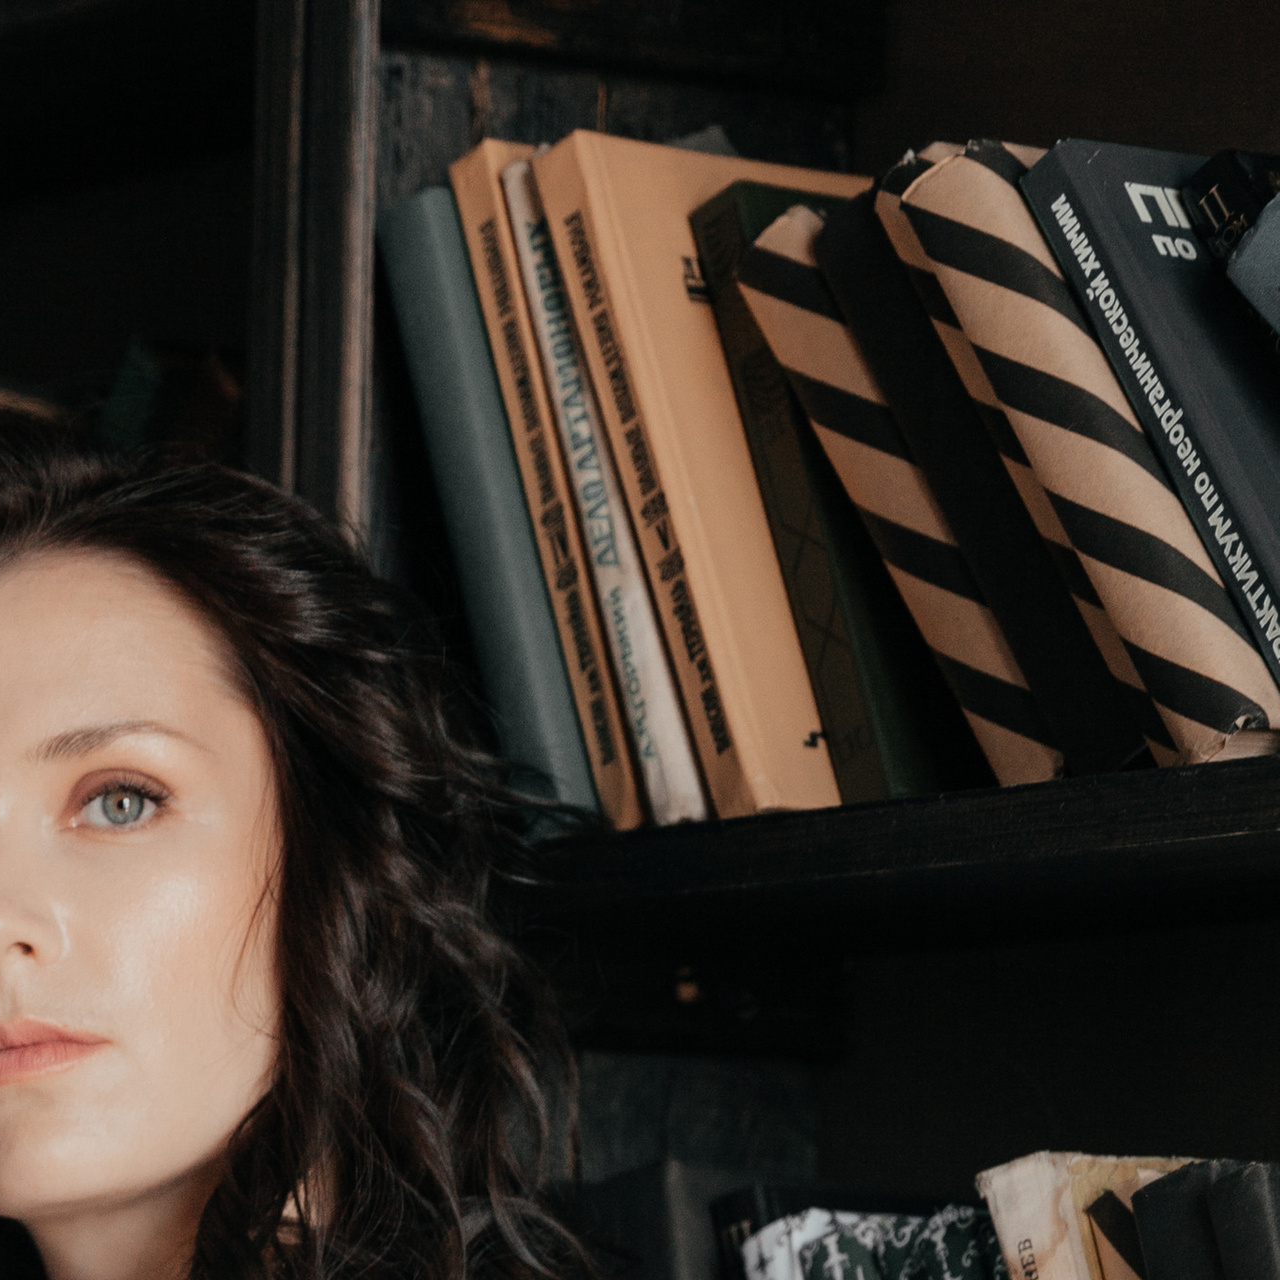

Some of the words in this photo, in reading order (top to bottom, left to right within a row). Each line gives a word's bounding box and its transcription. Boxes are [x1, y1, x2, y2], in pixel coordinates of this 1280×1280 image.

[1051, 192, 1101, 274] химии
[1152, 234, 1197, 260] по
[1084, 271, 1202, 478] неорганической
[1194, 472, 1220, 512] по
